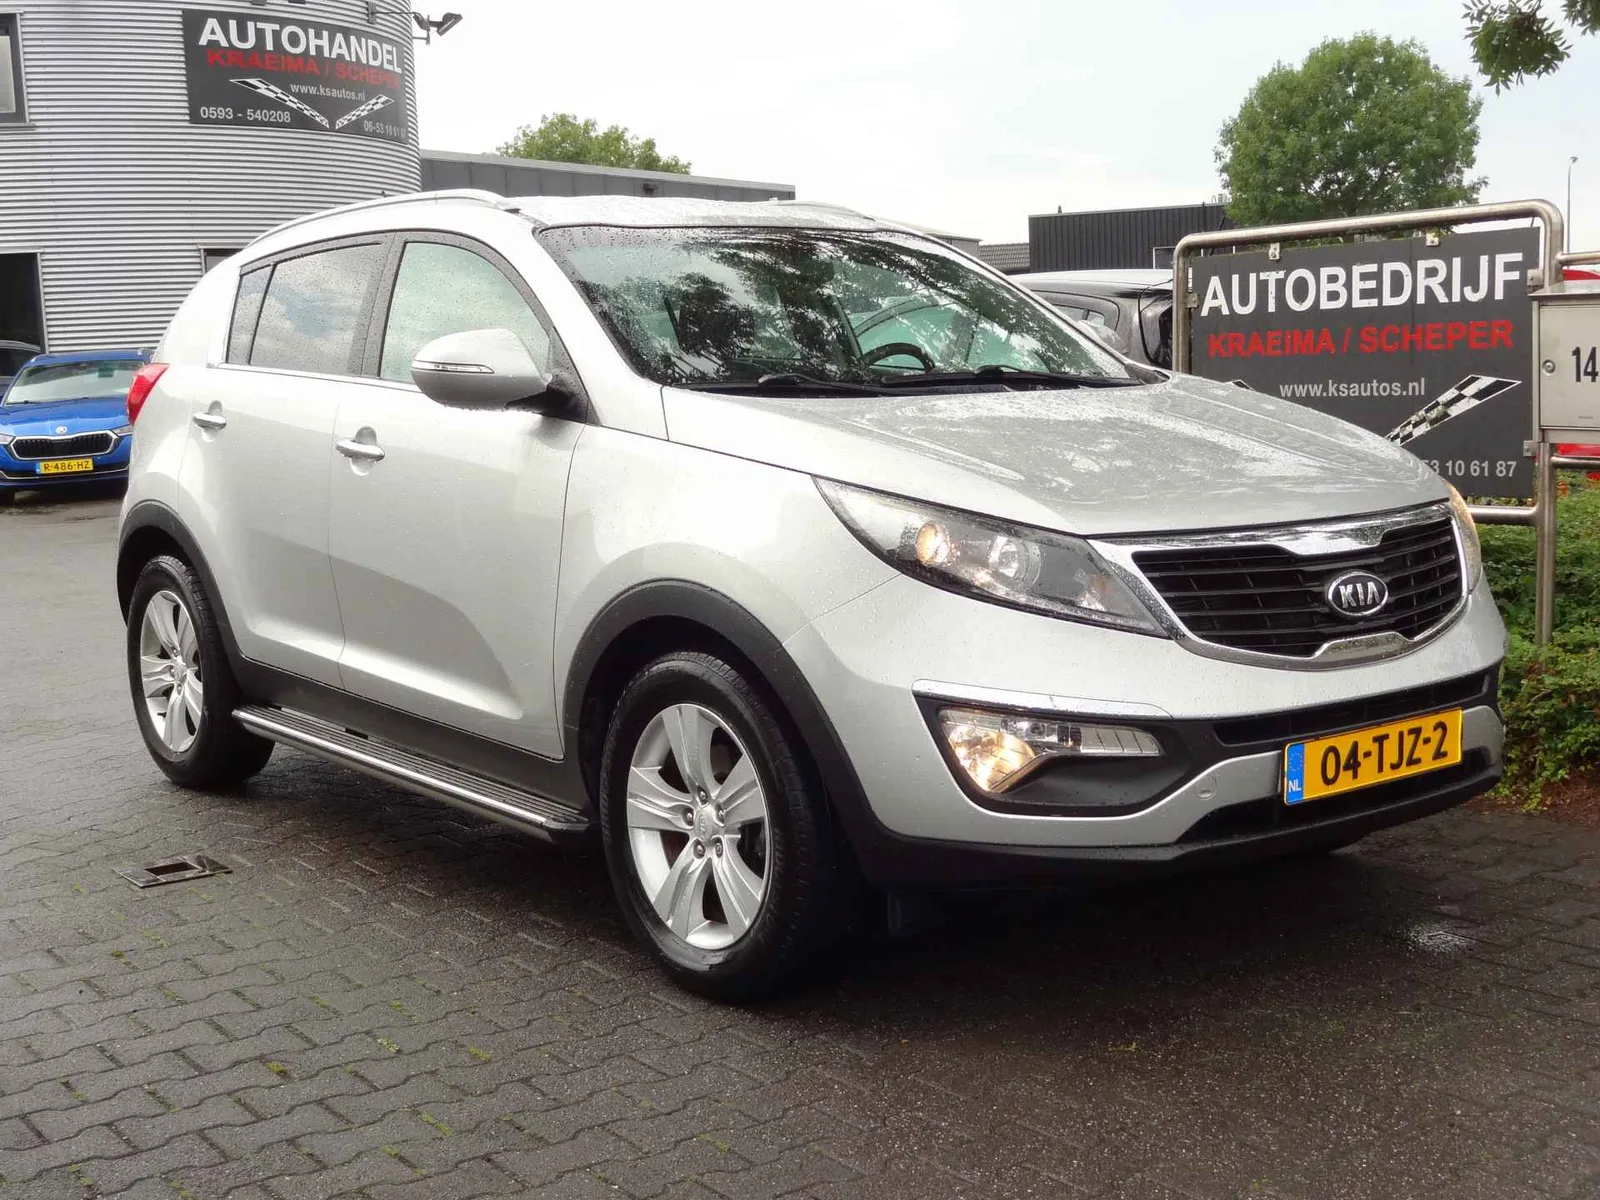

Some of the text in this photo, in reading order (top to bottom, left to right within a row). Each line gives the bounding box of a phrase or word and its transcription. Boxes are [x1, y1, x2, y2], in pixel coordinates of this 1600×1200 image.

[198, 18, 402, 73] AUTOHANDEL
[206, 48, 321, 76] KRAEIMA
[290, 84, 366, 101] www.ksautos.nl
[200, 106, 233, 120] 0593
[246, 108, 291, 123] 540208
[1200, 252, 1523, 317] AUTOBEDRIJF
[1208, 319, 1514, 359] KRAEIMA / SCHEPER
[1571, 346, 1599, 383] 14
[1279, 377, 1425, 398] www.ksautos.nl
[43, 460, 90, 472] R-486-HZ
[1446, 460, 1465, 476] 10
[1470, 460, 1489, 477] 61
[1496, 460, 1517, 477] 87
[1338, 581, 1380, 609] KIA
[1320, 720, 1449, 787] 04-TJZ-2
[1288, 780, 1302, 793] NL
